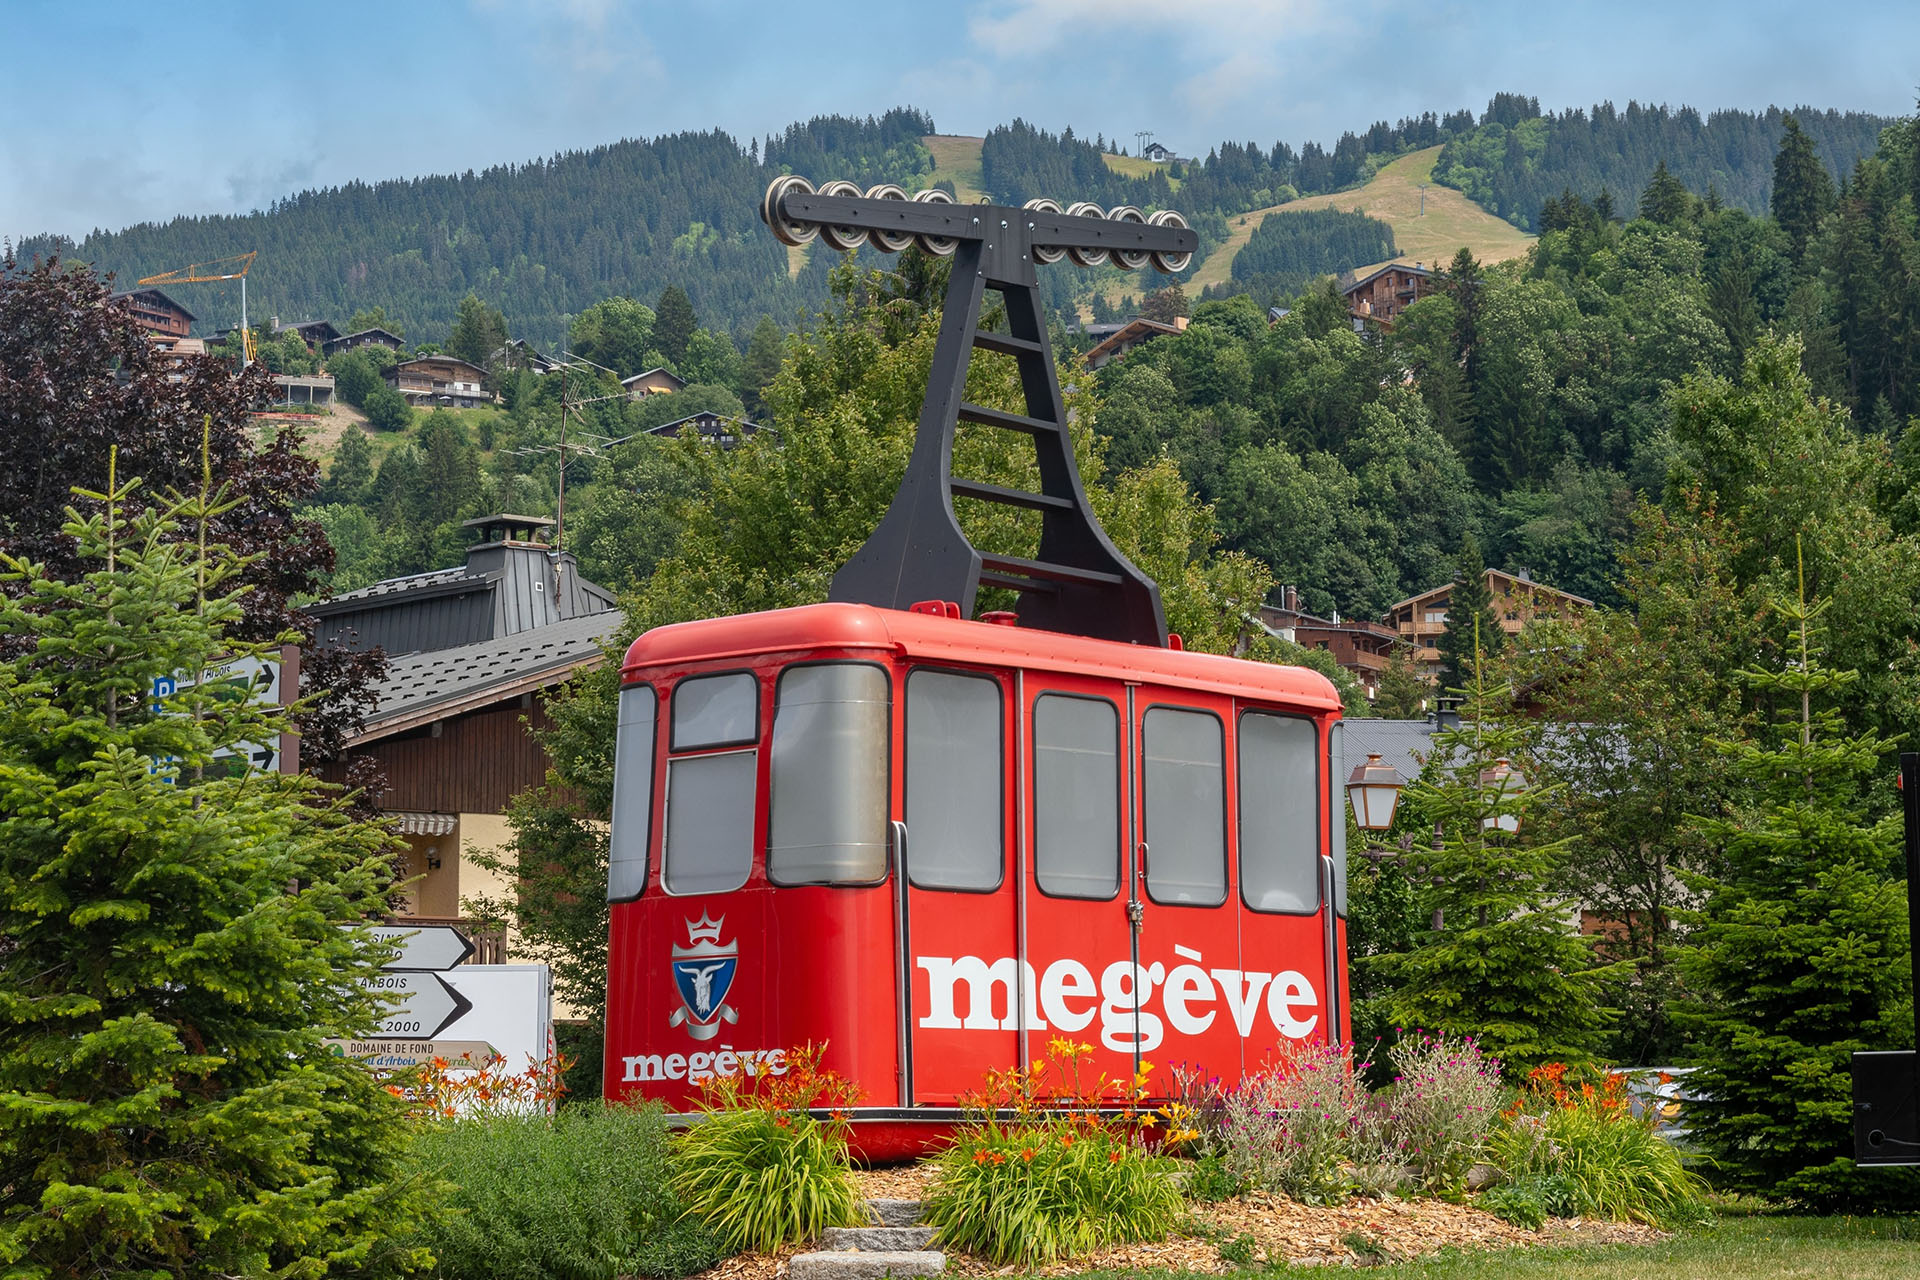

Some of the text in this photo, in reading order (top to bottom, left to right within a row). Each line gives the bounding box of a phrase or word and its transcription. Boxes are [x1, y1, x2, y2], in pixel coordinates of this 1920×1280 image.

[916, 943, 1319, 1053] megève
[385, 1021, 421, 1032] 2000
[350, 1043, 434, 1054] DOMAINE DE FOND
[376, 1055, 416, 1067] d'Arbois
[621, 1044, 789, 1087] megève
